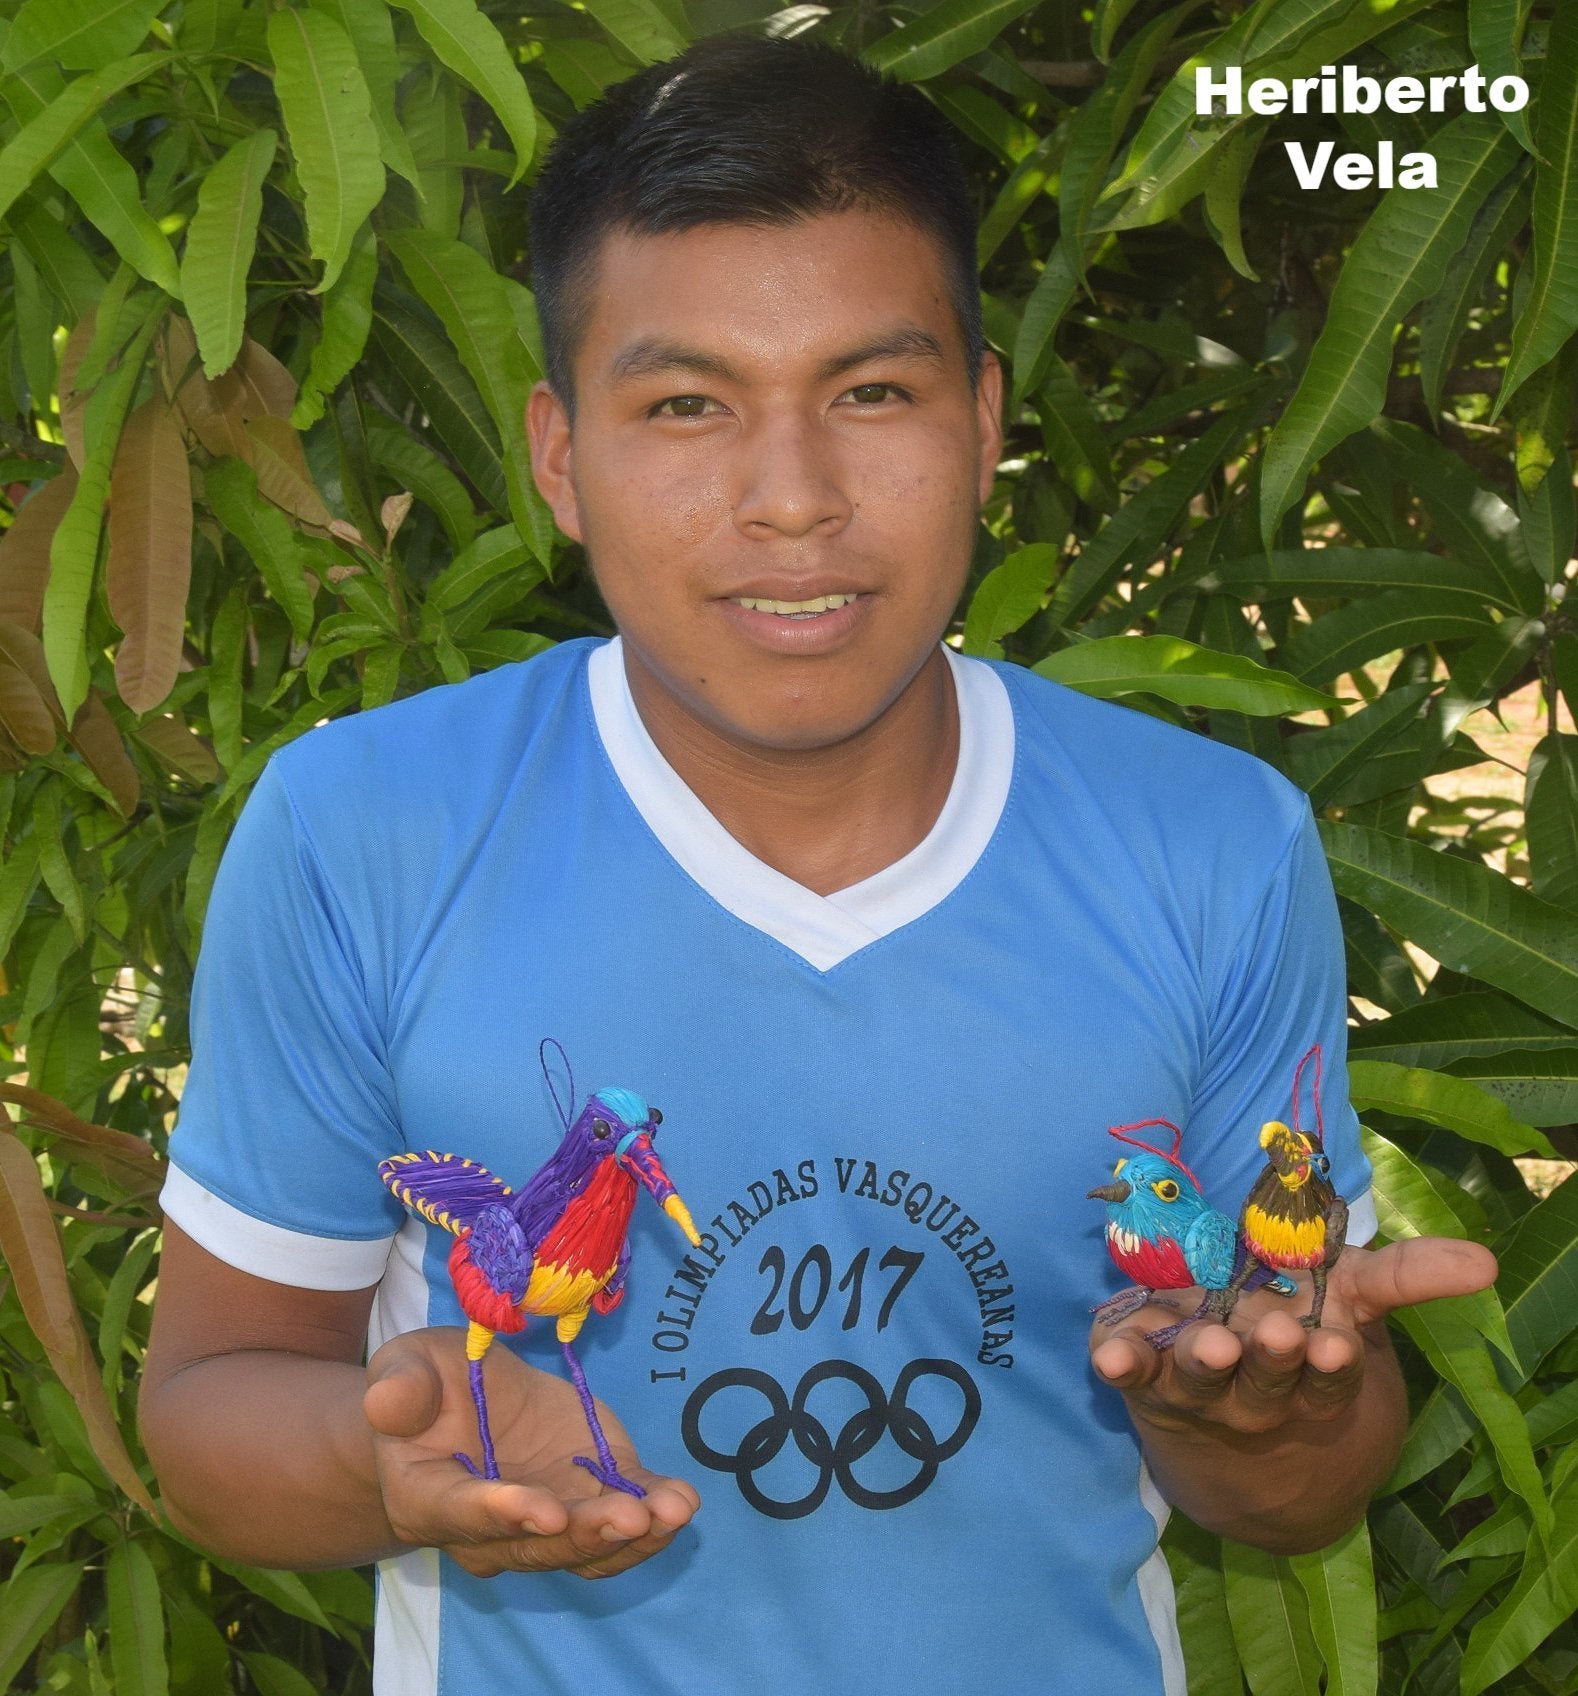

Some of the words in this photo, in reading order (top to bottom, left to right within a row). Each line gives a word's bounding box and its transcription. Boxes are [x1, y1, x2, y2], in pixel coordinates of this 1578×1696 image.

[651, 1159, 819, 1353] OLIMPIADAS
[749, 1243, 926, 1335] 2017
[834, 1157, 1016, 1369] VASQUEREANAS
[650, 1366, 687, 1384] I
